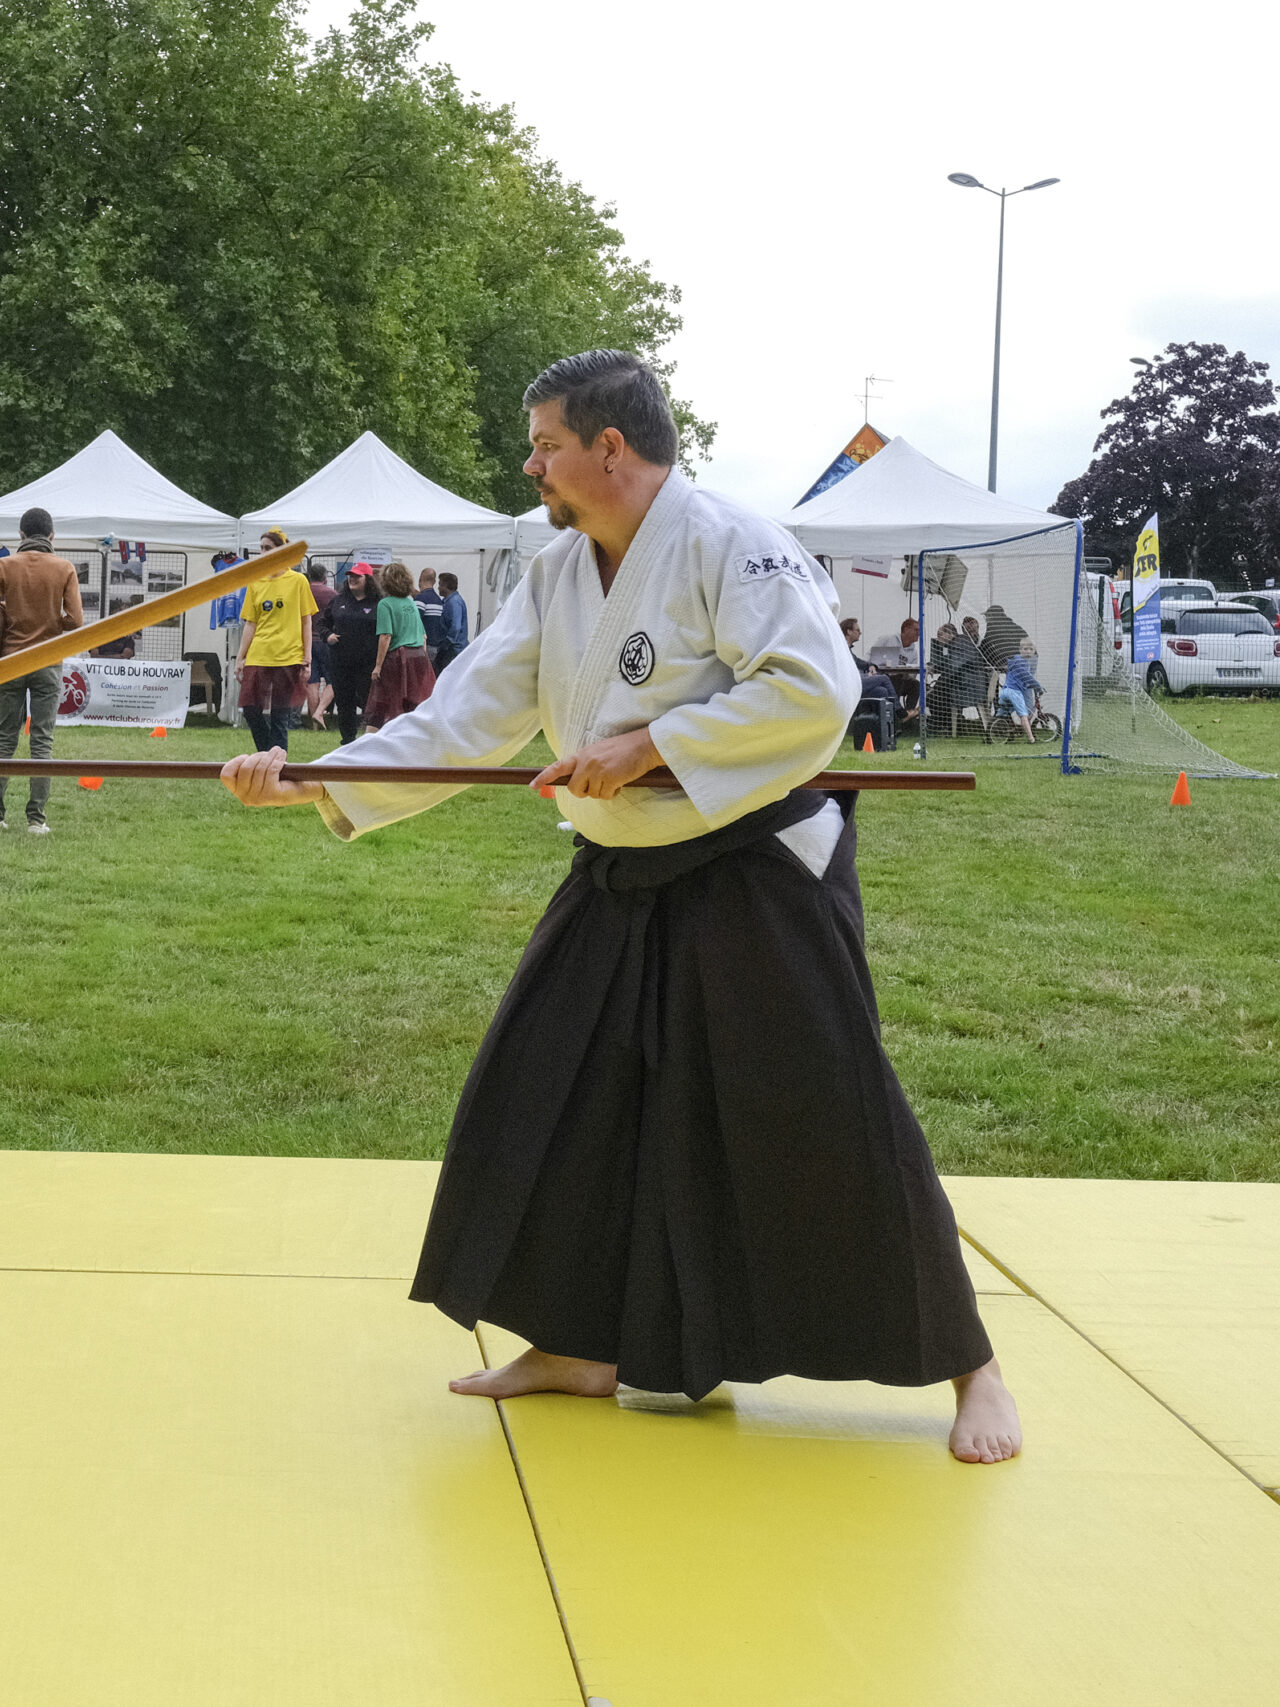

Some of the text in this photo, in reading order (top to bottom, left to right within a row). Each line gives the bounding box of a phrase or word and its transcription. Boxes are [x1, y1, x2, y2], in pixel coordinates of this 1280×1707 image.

[86, 664, 184, 678] VTT CLUB DU ROUVRAY
[84, 714, 181, 725] www.vttclubdurouvray.fr
